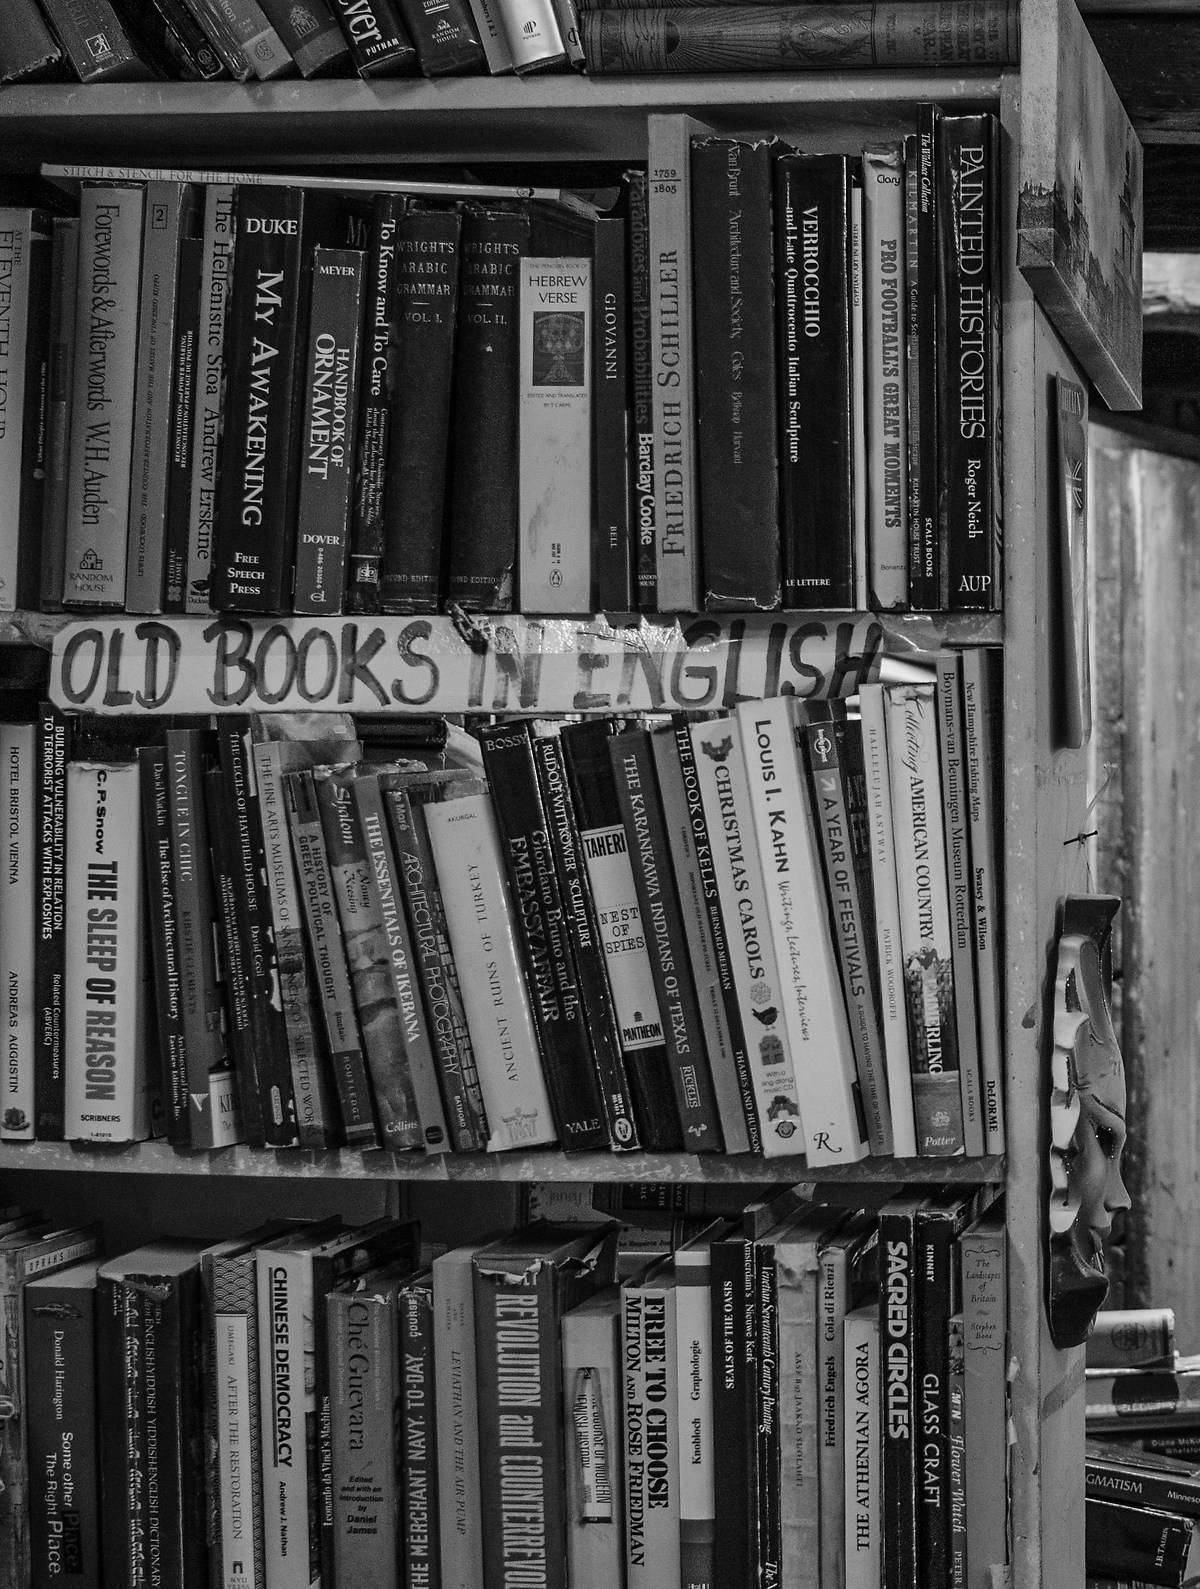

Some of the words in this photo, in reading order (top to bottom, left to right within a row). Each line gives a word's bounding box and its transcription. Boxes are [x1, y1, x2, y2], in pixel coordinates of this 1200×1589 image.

[366, 39, 399, 55] PUTNAM
[432, 27, 459, 39] RANDOM
[215, 195, 233, 232] The
[247, 218, 297, 235] DUKE
[959, 145, 984, 274] PAINTED
[90, 205, 120, 294] Forewords
[319, 265, 355, 277] MEYER
[802, 206, 820, 337] VERROCCHIO
[881, 240, 897, 273] PRO
[93, 297, 116, 311] &
[209, 240, 231, 346] Hellenistic
[253, 269, 284, 325] MY
[530, 276, 587, 286] HEBREW
[539, 293, 577, 303] VERSE
[605, 293, 617, 379] GIOVANNI
[656, 251, 681, 388] SCHILLER
[882, 278, 899, 377] FOOTBALL'S
[87, 313, 114, 410] Afterwords
[205, 354, 225, 395] Stoa
[959, 284, 986, 439] HISTORIES
[308, 334, 336, 479] ORNAMENT
[331, 348, 350, 441] HANDBOOK
[883, 382, 900, 438] GREAT
[85, 421, 111, 463] W.H.
[201, 407, 220, 480] Andrew
[242, 337, 279, 526] AWAKENING
[331, 445, 344, 467] OF
[638, 433, 654, 493] Barclay
[662, 402, 686, 557] FRIEDRICH
[884, 442, 901, 527] MOMENTS
[966, 459, 981, 498] Roger
[81, 468, 108, 525] Auden
[639, 496, 656, 544] Cooke
[967, 501, 984, 538] Neich
[196, 488, 216, 559] Erskine
[303, 534, 340, 545] DOVER
[609, 526, 618, 548] BELL
[924, 518, 933, 544] SCALA
[926, 548, 934, 577] BOOKS
[959, 575, 991, 592] AUP
[61, 622, 181, 709] OLD
[203, 619, 439, 706] BOOKS
[468, 623, 545, 709] IN
[45, 716, 54, 728] TO
[675, 727, 691, 762] THE
[9, 746, 20, 785] HOTEL
[44, 731, 53, 791] TERRORIST
[54, 726, 64, 775] BUILDING
[623, 754, 639, 790] THE
[755, 720, 776, 782] LOUIS
[9, 788, 19, 839] BRISTOL
[332, 784, 357, 845] Shalom
[683, 767, 701, 816] BOOK
[765, 788, 781, 805] I.
[824, 798, 837, 809] A
[43, 795, 53, 843] ATTACKS
[53, 778, 64, 861] VULNERABILITY
[363, 812, 383, 853] THE
[692, 819, 706, 842] OF
[768, 811, 789, 873] KAHN
[827, 814, 845, 862] YEAR
[910, 777, 929, 860] AMERICAN
[8, 842, 19, 884] VIENNA
[43, 846, 53, 874] WITH
[54, 864, 64, 875] IN
[584, 840, 626, 858] TAHERI
[630, 794, 659, 898] KARANKAWA
[88, 861, 118, 901] THE
[695, 845, 716, 898] KELLS
[713, 765, 748, 891] CHRISTMAS
[737, 901, 765, 980] CAROLS
[835, 870, 850, 892] OF
[43, 877, 53, 939] EXPLOSIVES
[54, 878, 63, 930] RELATION
[371, 855, 403, 947] ESSENTIALS
[600, 910, 639, 924] NEST
[915, 865, 935, 941] COUNTRY
[87, 908, 118, 972] SLEEP
[509, 836, 543, 941] EMBASSY
[529, 945, 560, 1020] AFFAIR
[607, 939, 644, 954] SPIES
[613, 925, 630, 937] OF
[649, 902, 672, 972] INDIANS
[839, 899, 865, 997] FESTIVALS
[389, 950, 407, 970] OF
[402, 852, 438, 962] ARCHITECTURAL
[425, 966, 459, 1074] PHOTOGRAPHY
[8, 971, 19, 1027] ANDREAS
[86, 978, 116, 1005] OF
[393, 972, 421, 1043] IKEBANA
[662, 976, 677, 999] OF
[623, 1022, 664, 1041] PANTHEON
[669, 1002, 690, 1054] TEXAS
[8, 1035, 19, 1094] AUGUSTIN
[85, 1010, 116, 1100] REASON
[683, 1065, 699, 1108] RICKLIS
[987, 1081, 998, 1132] DeLORME
[80, 1114, 121, 1122] SCRIBNERS
[925, 1136, 957, 1146] Potter
[762, 1266, 772, 1302] Venetian
[926, 1244, 935, 1282] KINNEY
[274, 1267, 288, 1344] CHINESE
[887, 1241, 908, 1337] SACRED
[54, 1330, 65, 1366] Donald
[228, 1325, 236, 1365] UMEGAKI
[347, 1303, 370, 1348] Ché
[496, 1294, 541, 1406] REVOLUTION
[626, 1297, 641, 1372] MILTON
[645, 1297, 665, 1362] FREE
[762, 1304, 773, 1358] Seventeenth
[52, 1370, 66, 1420] Harington
[627, 1375, 636, 1399] AND
[646, 1368, 666, 1403] TO
[690, 1341, 701, 1400] Graphologie
[761, 1359, 774, 1395] Century
[855, 1343, 869, 1407] AGORA
[888, 1343, 909, 1439] CIRCLES
[228, 1375, 239, 1416] AFTER
[275, 1350, 292, 1467] DEMOCRACY
[348, 1354, 368, 1451] Guevara
[760, 1397, 774, 1434] Painting
[923, 1374, 939, 1434] GLASS
[229, 1421, 239, 1446] THE
[499, 1415, 542, 1447] and
[628, 1403, 643, 1455] ROSE
[692, 1418, 701, 1464] Knobloch
[46, 1452, 58, 1476] The
[646, 1408, 669, 1509] CHOOSE
[856, 1412, 869, 1509] ATHENIAN
[924, 1443, 940, 1507] CRAFT
[950, 1435, 965, 1484] Flower
[44, 1481, 59, 1516] Right
[229, 1450, 242, 1539] RESTORATION
[629, 1460, 645, 1567] FRIEDMAN
[952, 1489, 966, 1534] Watch
[47, 1520, 64, 1578] Place.
[857, 1514, 870, 1551] THE
